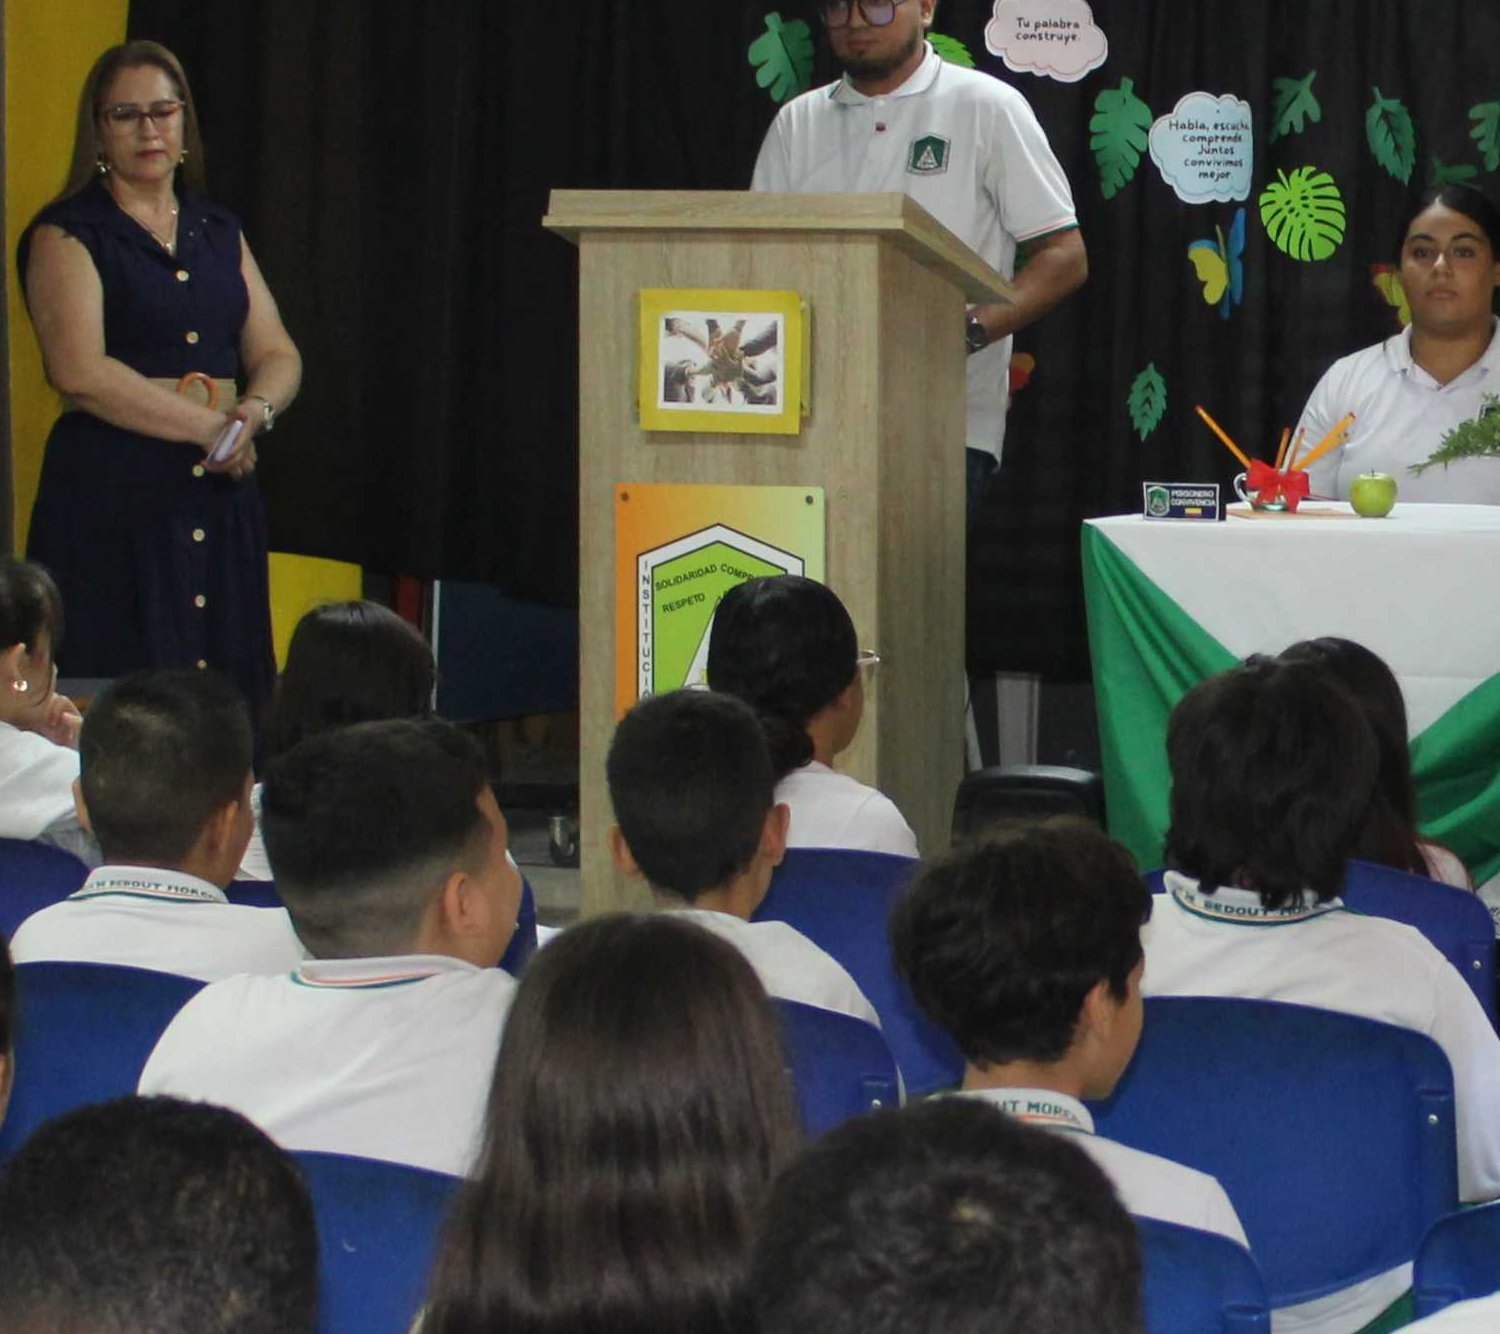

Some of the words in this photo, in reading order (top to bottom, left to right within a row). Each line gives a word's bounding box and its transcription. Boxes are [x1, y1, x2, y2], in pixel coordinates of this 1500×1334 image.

[1016, 17, 1030, 28] Tu
[1034, 18, 1080, 31] palabra
[1168, 119, 1210, 132] Habla,
[655, 564, 718, 592] SOLIDARIDAD
[662, 592, 706, 613] RESPETO
